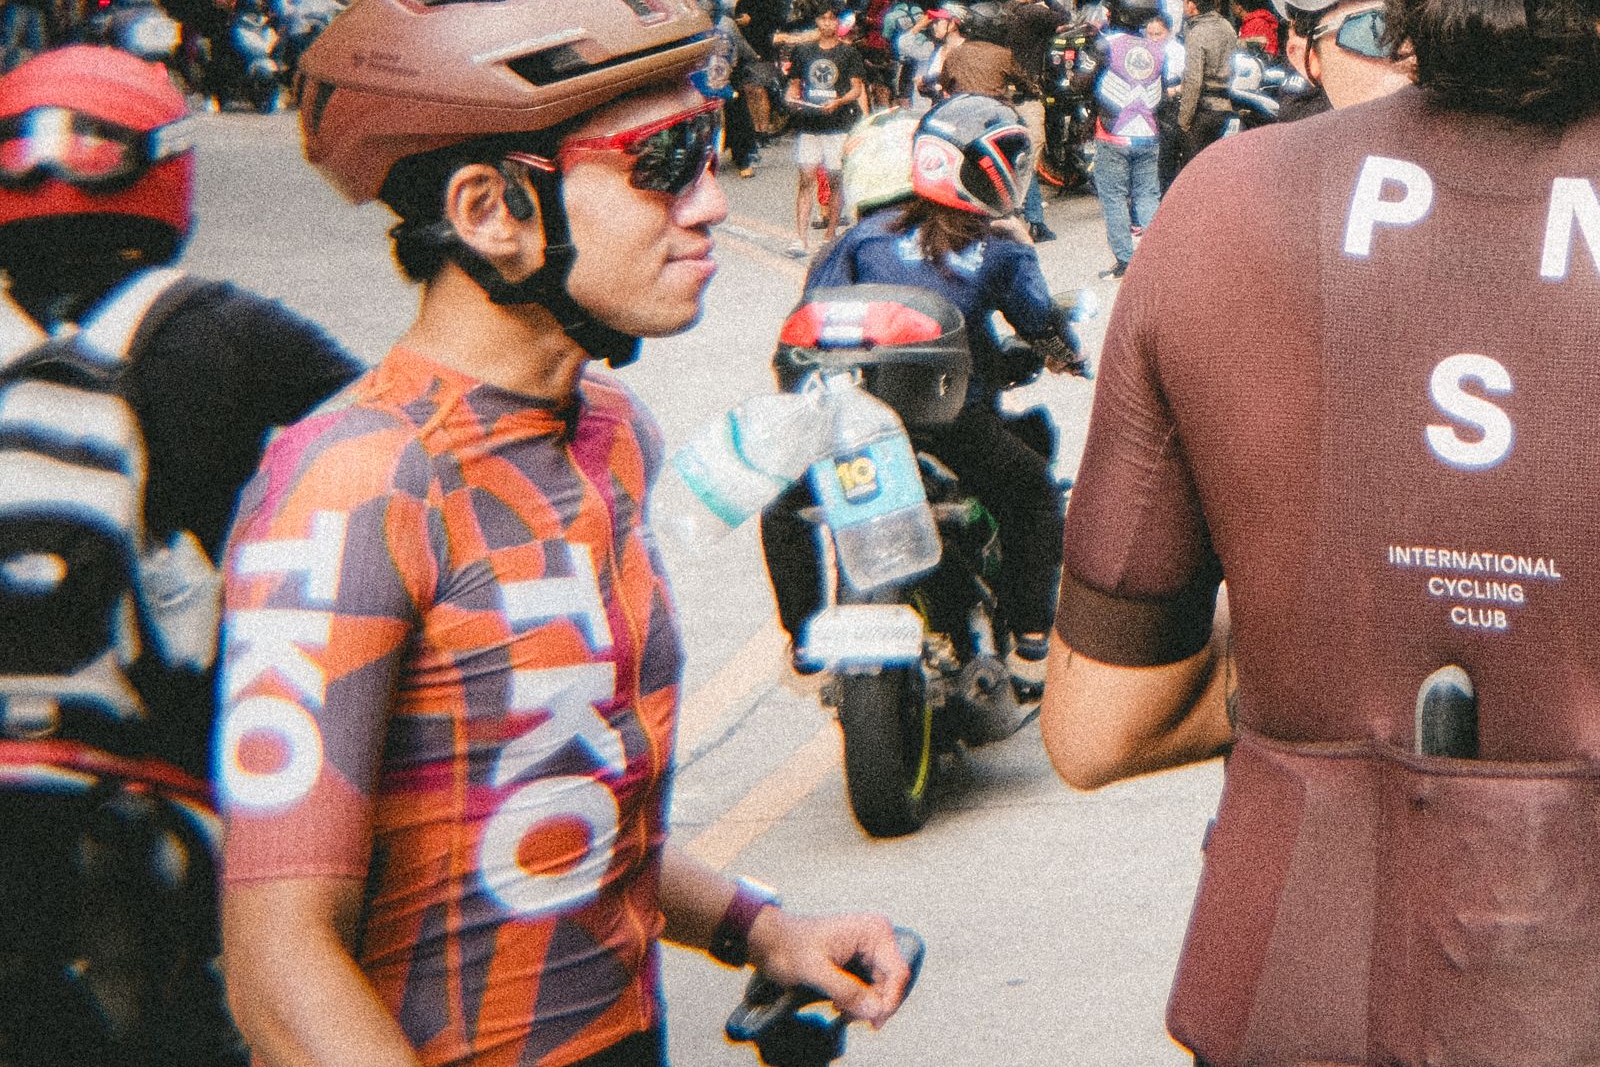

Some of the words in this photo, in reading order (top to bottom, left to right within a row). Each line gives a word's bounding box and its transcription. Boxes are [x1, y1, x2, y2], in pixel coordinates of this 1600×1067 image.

[1343, 154, 1434, 256] P
[1424, 352, 1514, 466] S
[1388, 545, 1562, 579] INTERNATIONAL
[1428, 577, 1525, 603] CYCLING
[222, 508, 348, 808] TKO
[1450, 606, 1508, 629] CLUB
[480, 540, 628, 914] TKO
